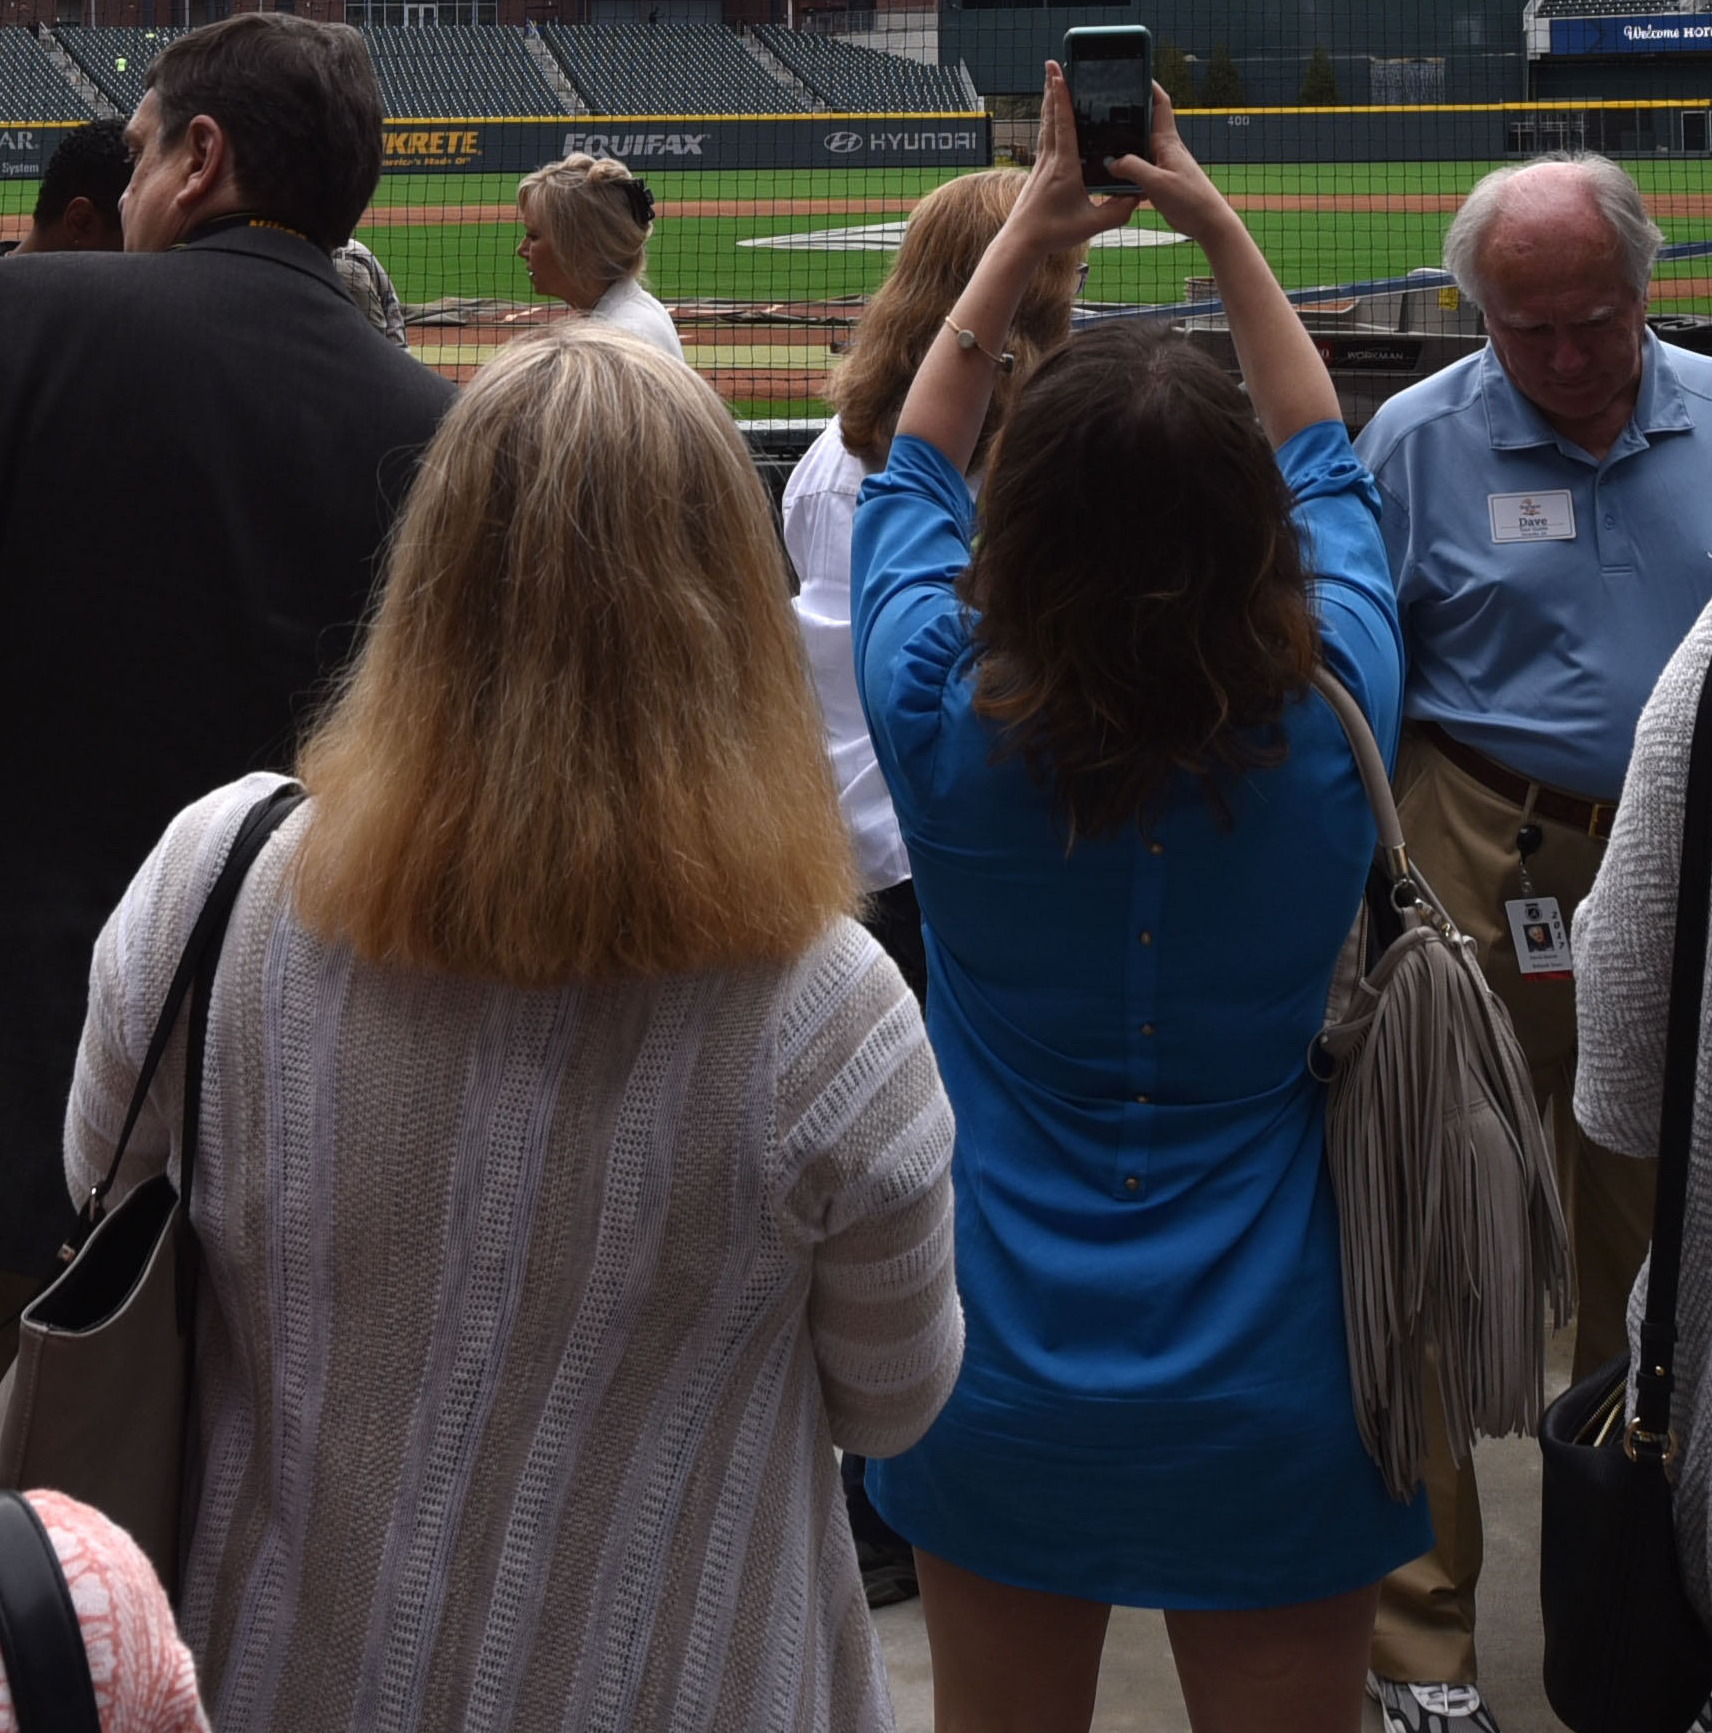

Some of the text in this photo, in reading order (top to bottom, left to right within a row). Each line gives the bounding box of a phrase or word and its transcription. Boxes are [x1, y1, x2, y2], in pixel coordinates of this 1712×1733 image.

[1227, 115, 1250, 126] 400
[562, 132, 706, 157] EQUIFAX
[870, 131, 977, 151] HYUNDAI
[1, 161, 40, 176] System
[1347, 351, 1404, 360] WORKMAN
[1519, 517, 1548, 527] Dave
